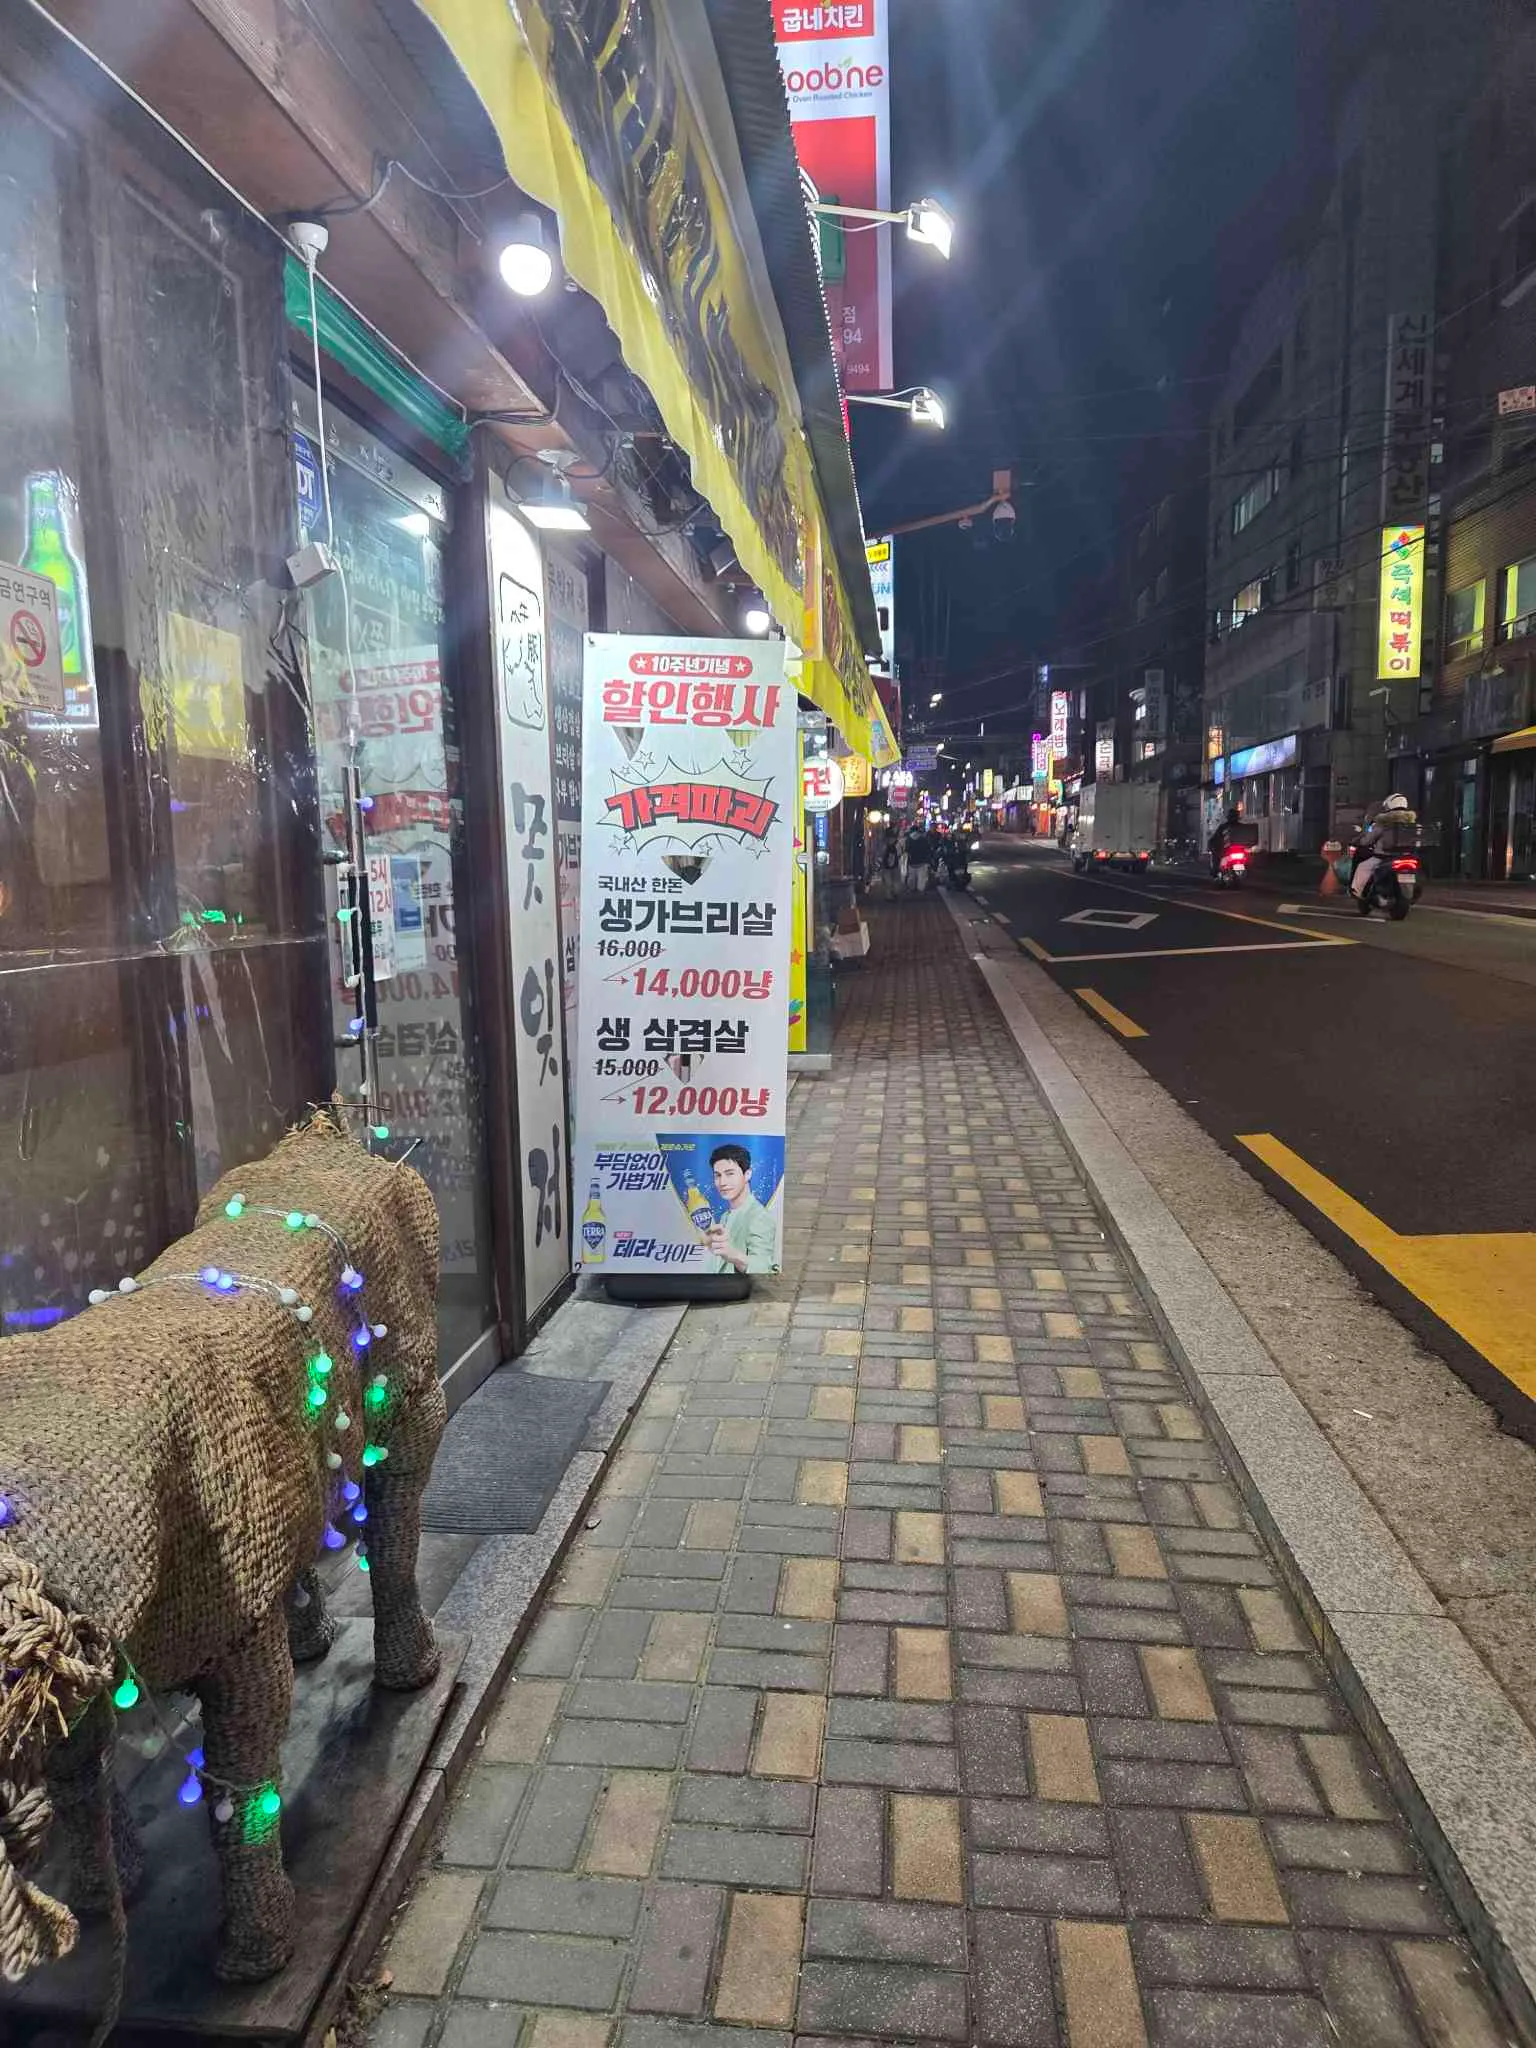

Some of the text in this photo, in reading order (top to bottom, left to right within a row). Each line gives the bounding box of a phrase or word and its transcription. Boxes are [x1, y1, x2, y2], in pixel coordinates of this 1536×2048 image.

[782, 5, 863, 32] 굽네치킨
[784, 62, 883, 92] oobne
[650, 654, 731, 673] 10주년기념
[602, 679, 781, 728] 할인행사
[598, 875, 647, 893] 국내산
[651, 876, 683, 894] 한돈
[599, 898, 776, 937] 생가브리살
[597, 938, 662, 957] 16,000
[632, 967, 773, 999] 14,000냥
[596, 1017, 749, 1054] 생 삼겹살
[594, 1059, 659, 1077] 15,000
[631, 1086, 771, 1117] 12,000냥
[594, 1153, 667, 1172] 부담없이
[606, 1172, 669, 1191] 가볍게!
